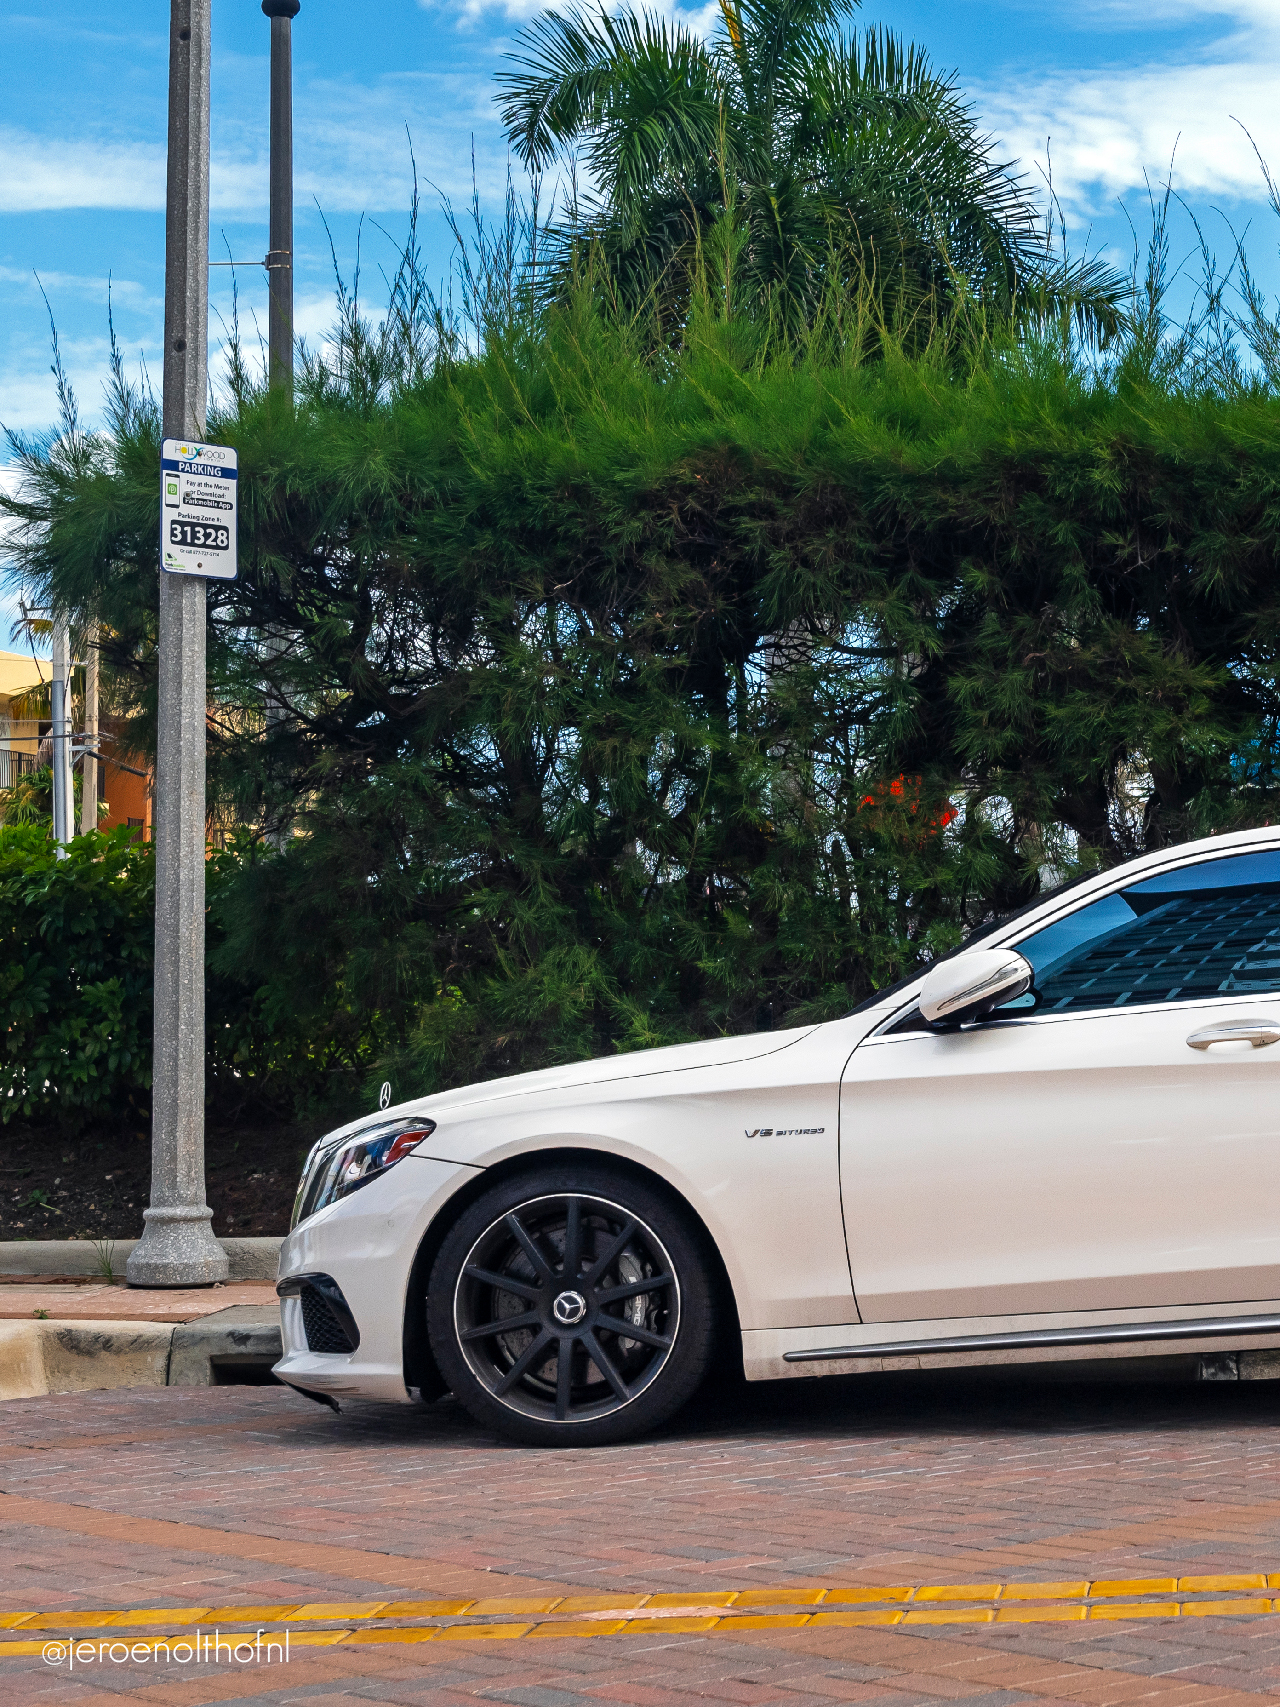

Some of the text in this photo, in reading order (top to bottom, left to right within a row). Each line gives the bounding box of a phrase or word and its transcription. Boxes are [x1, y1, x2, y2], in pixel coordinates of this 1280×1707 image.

[178, 462, 221, 476] PARKING
[196, 490, 226, 499] Download:
[185, 498, 230, 510] Parkmobile App
[178, 512, 200, 521] Parking
[171, 524, 228, 546] 31328
[776, 1128, 825, 1136] BITURBO
[633, 1295, 642, 1326] AMG
